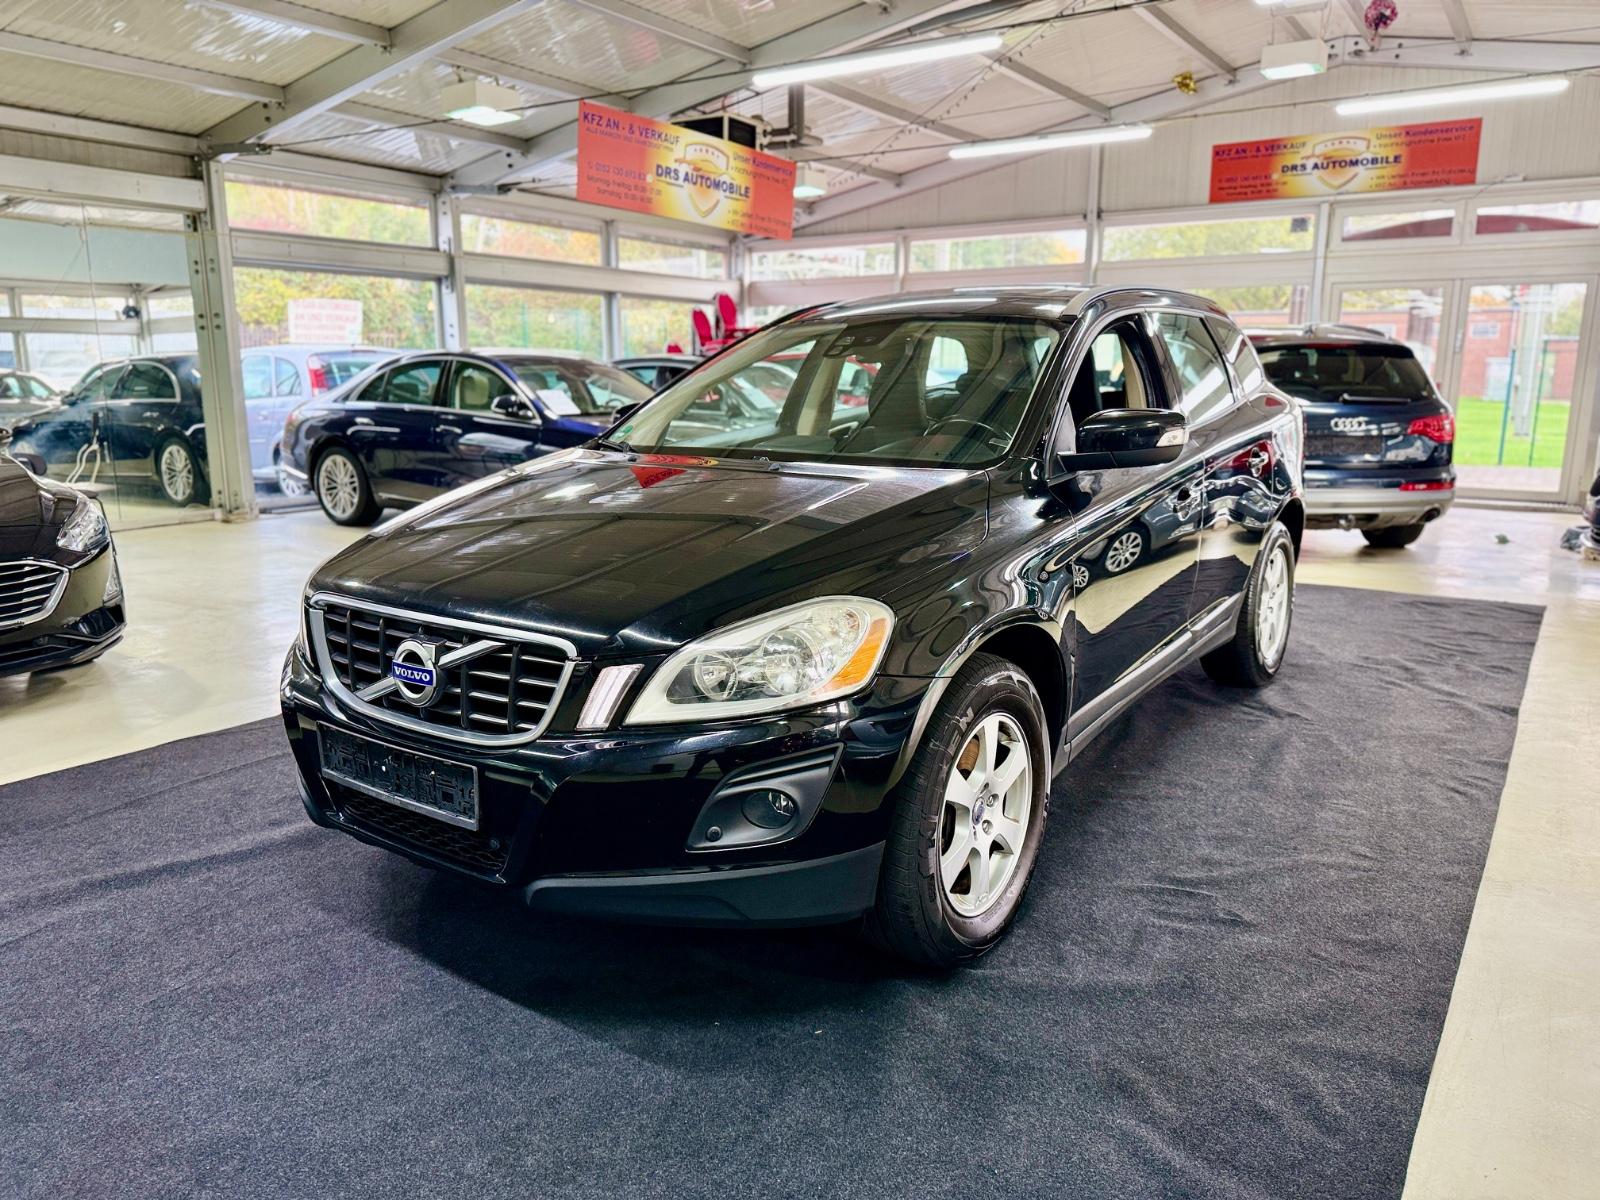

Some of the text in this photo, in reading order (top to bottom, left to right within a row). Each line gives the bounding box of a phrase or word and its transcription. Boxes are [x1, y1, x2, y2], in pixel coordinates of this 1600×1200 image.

[583, 111, 603, 127] KFZ
[605, 118, 620, 130] AN
[639, 126, 680, 146] VERKAUF
[1215, 147, 1232, 158] KFZ
[1235, 147, 1248, 155] AN
[1264, 142, 1307, 153] VERKAUF
[1281, 163, 1307, 174] DRS
[1311, 154, 1402, 171] AUTOMOBILE
[656, 164, 680, 181] DRS
[683, 171, 751, 199] AUTOMOBILE
[393, 665, 431, 682] VOLVO
